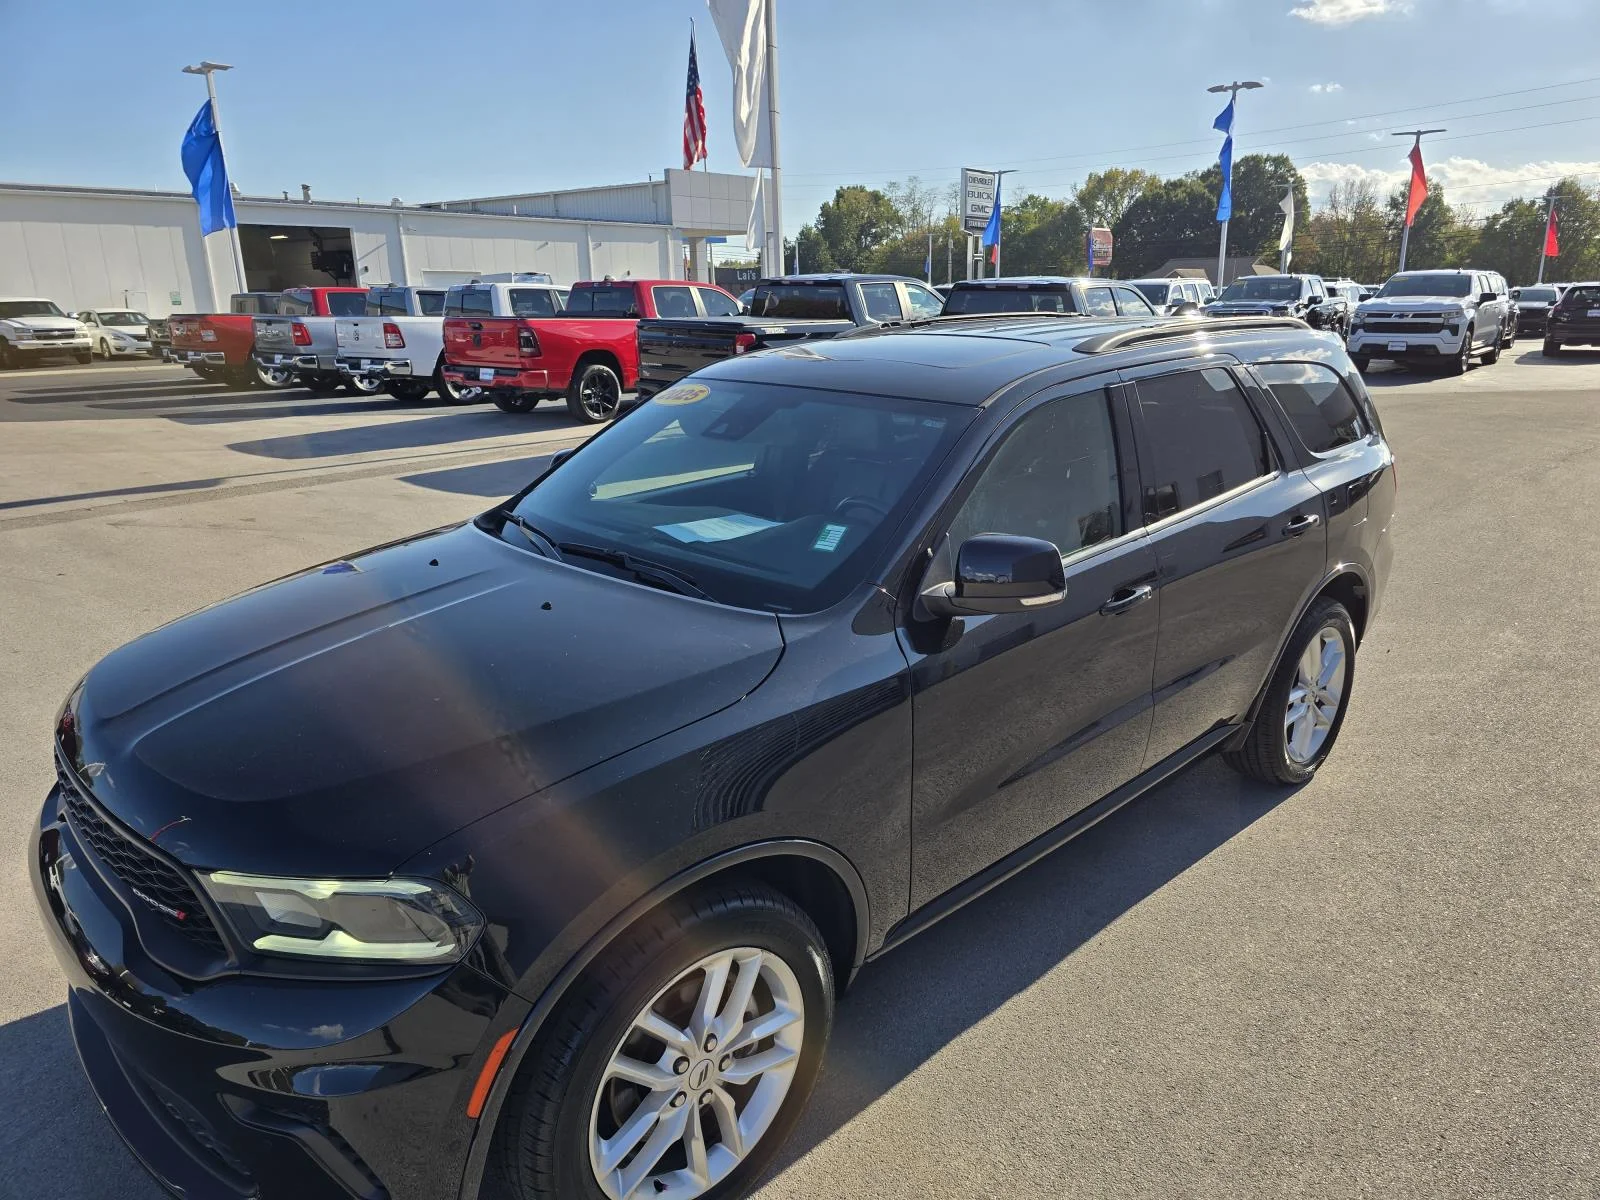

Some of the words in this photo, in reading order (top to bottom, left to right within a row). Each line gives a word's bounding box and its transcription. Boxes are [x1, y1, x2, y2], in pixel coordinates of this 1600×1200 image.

[968, 175, 993, 186] CHEVROLET
[967, 190, 993, 201] BUICK
[970, 203, 990, 214] GMC
